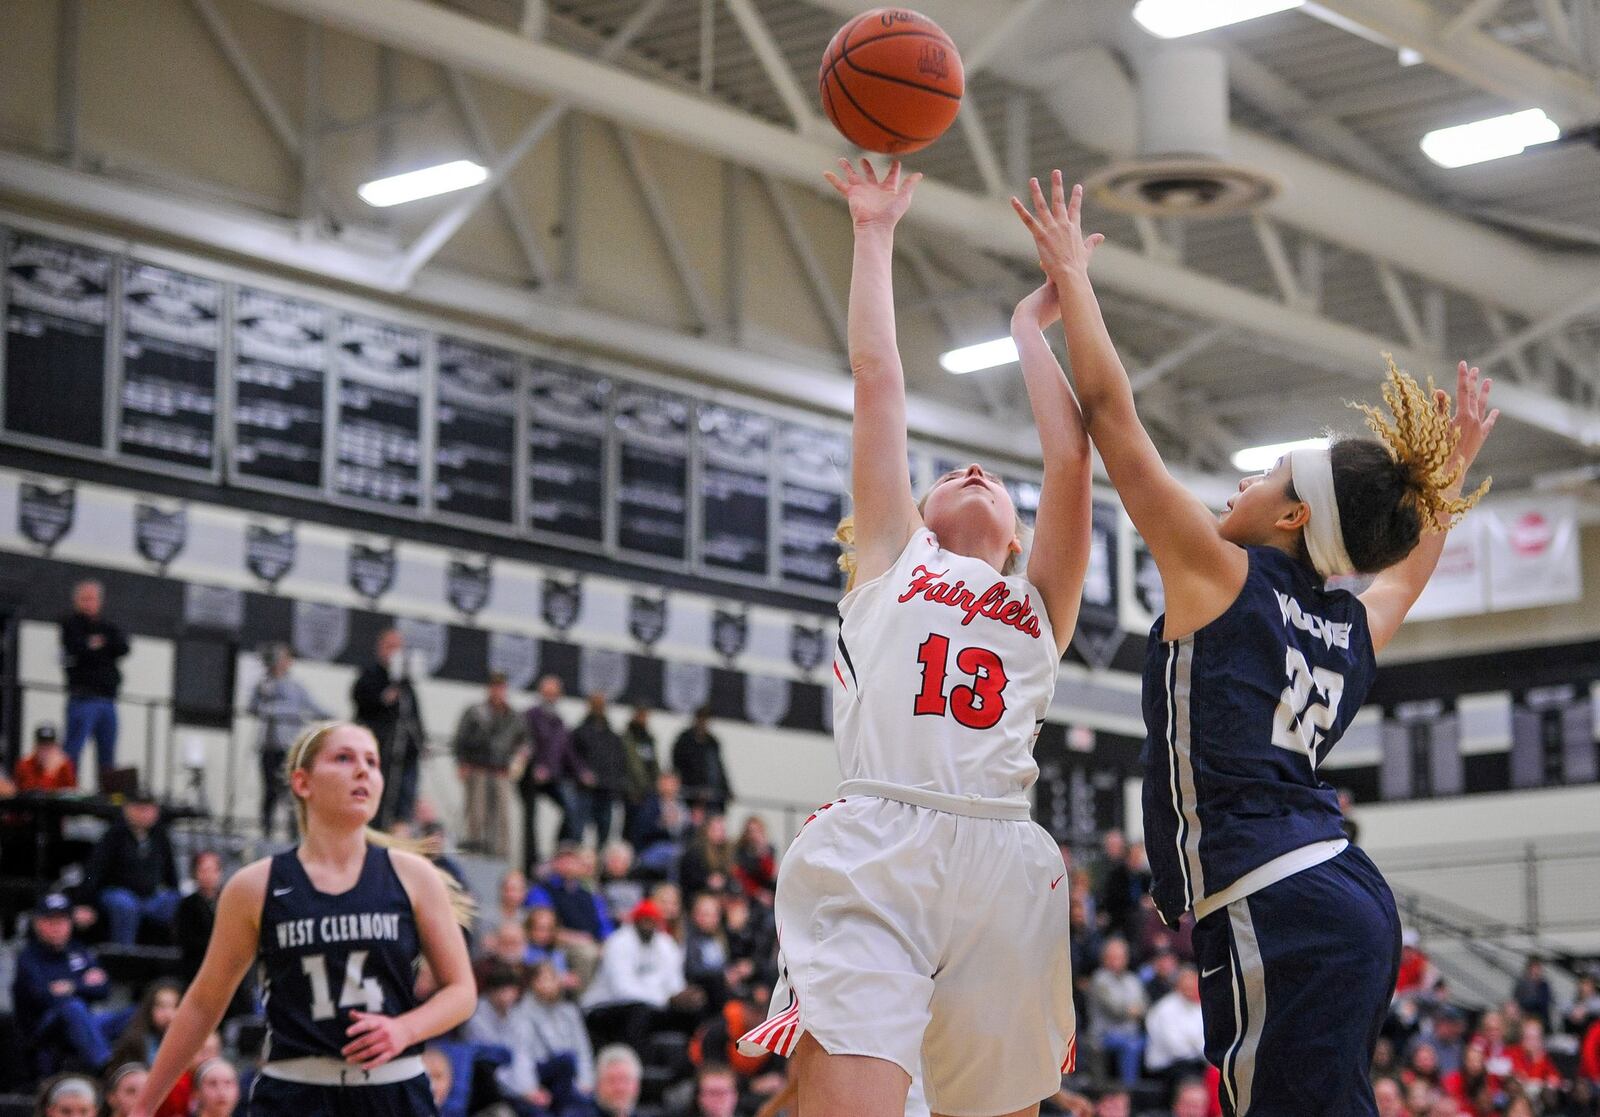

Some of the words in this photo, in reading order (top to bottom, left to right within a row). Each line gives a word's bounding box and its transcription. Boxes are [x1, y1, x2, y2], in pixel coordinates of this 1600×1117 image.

[914, 632, 1010, 730] 13
[1271, 645, 1344, 771] 22
[276, 918, 315, 949] WEST
[321, 912, 399, 943] CLERMONT
[301, 950, 384, 1021] 14
